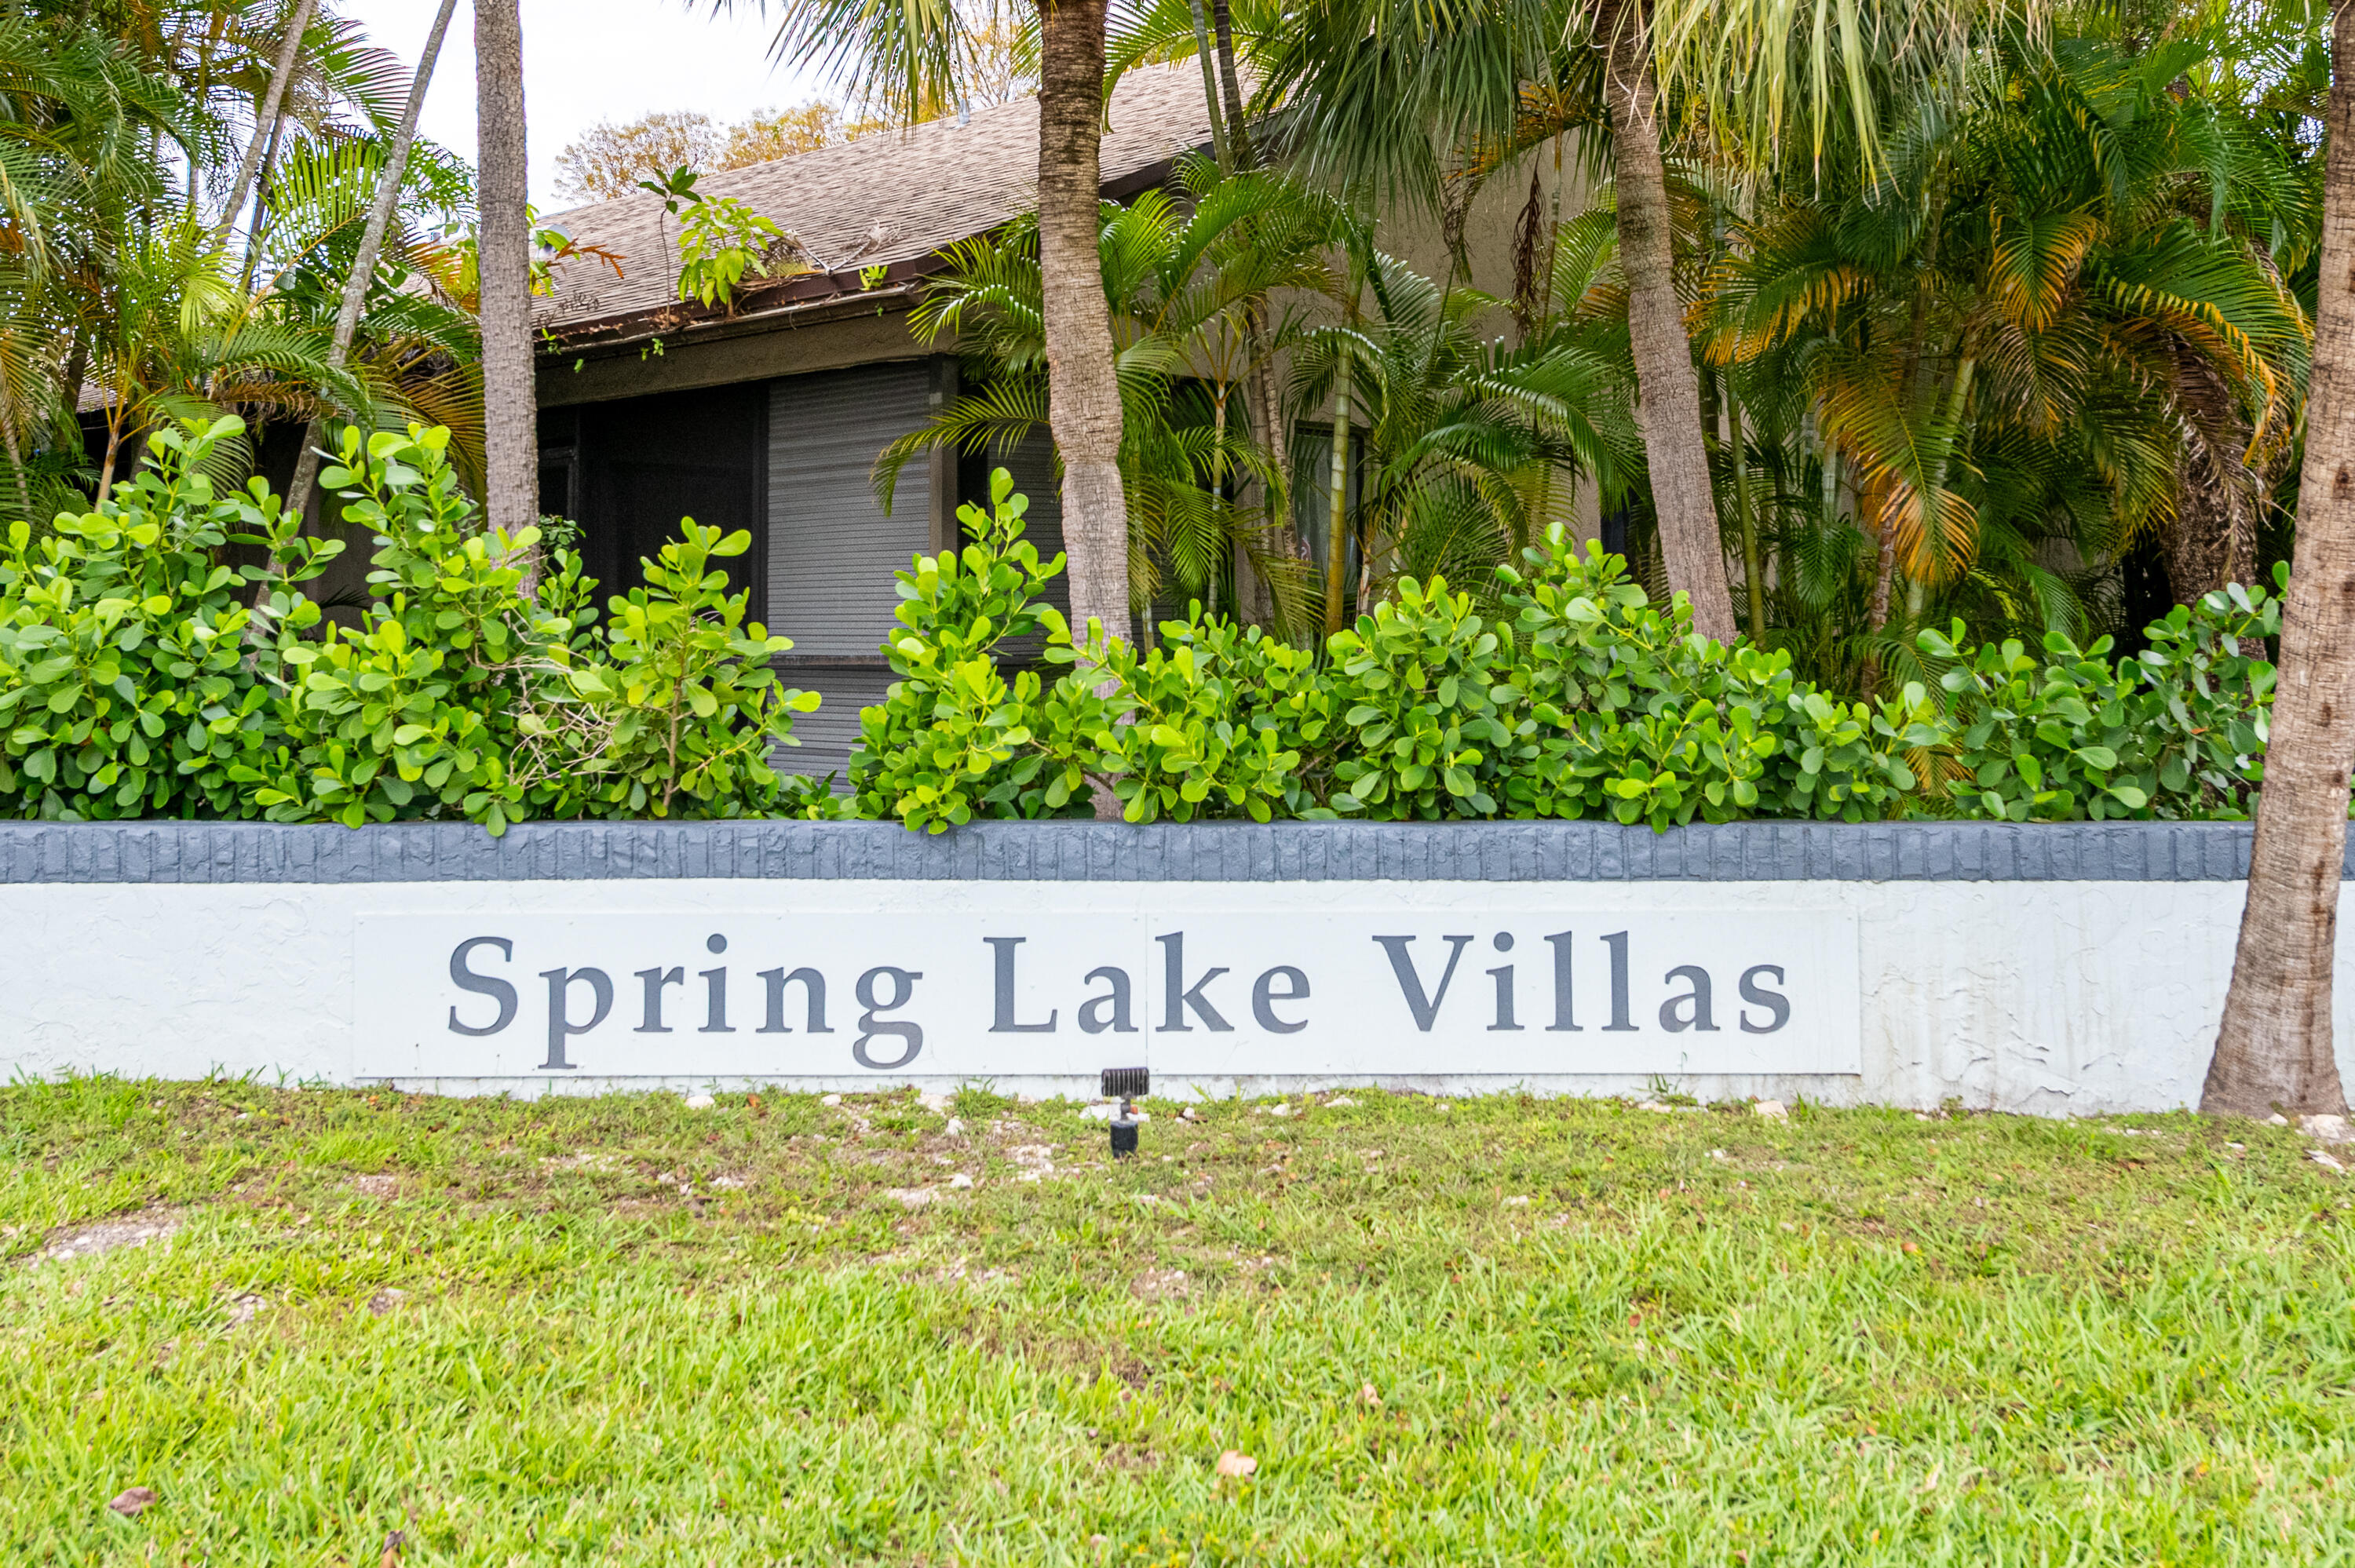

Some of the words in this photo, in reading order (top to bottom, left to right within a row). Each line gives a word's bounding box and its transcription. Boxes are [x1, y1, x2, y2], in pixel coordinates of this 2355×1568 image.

[448, 933, 923, 1070] Spring
[983, 931, 1310, 1034] Lake
[1371, 930, 1791, 1034] Villas
